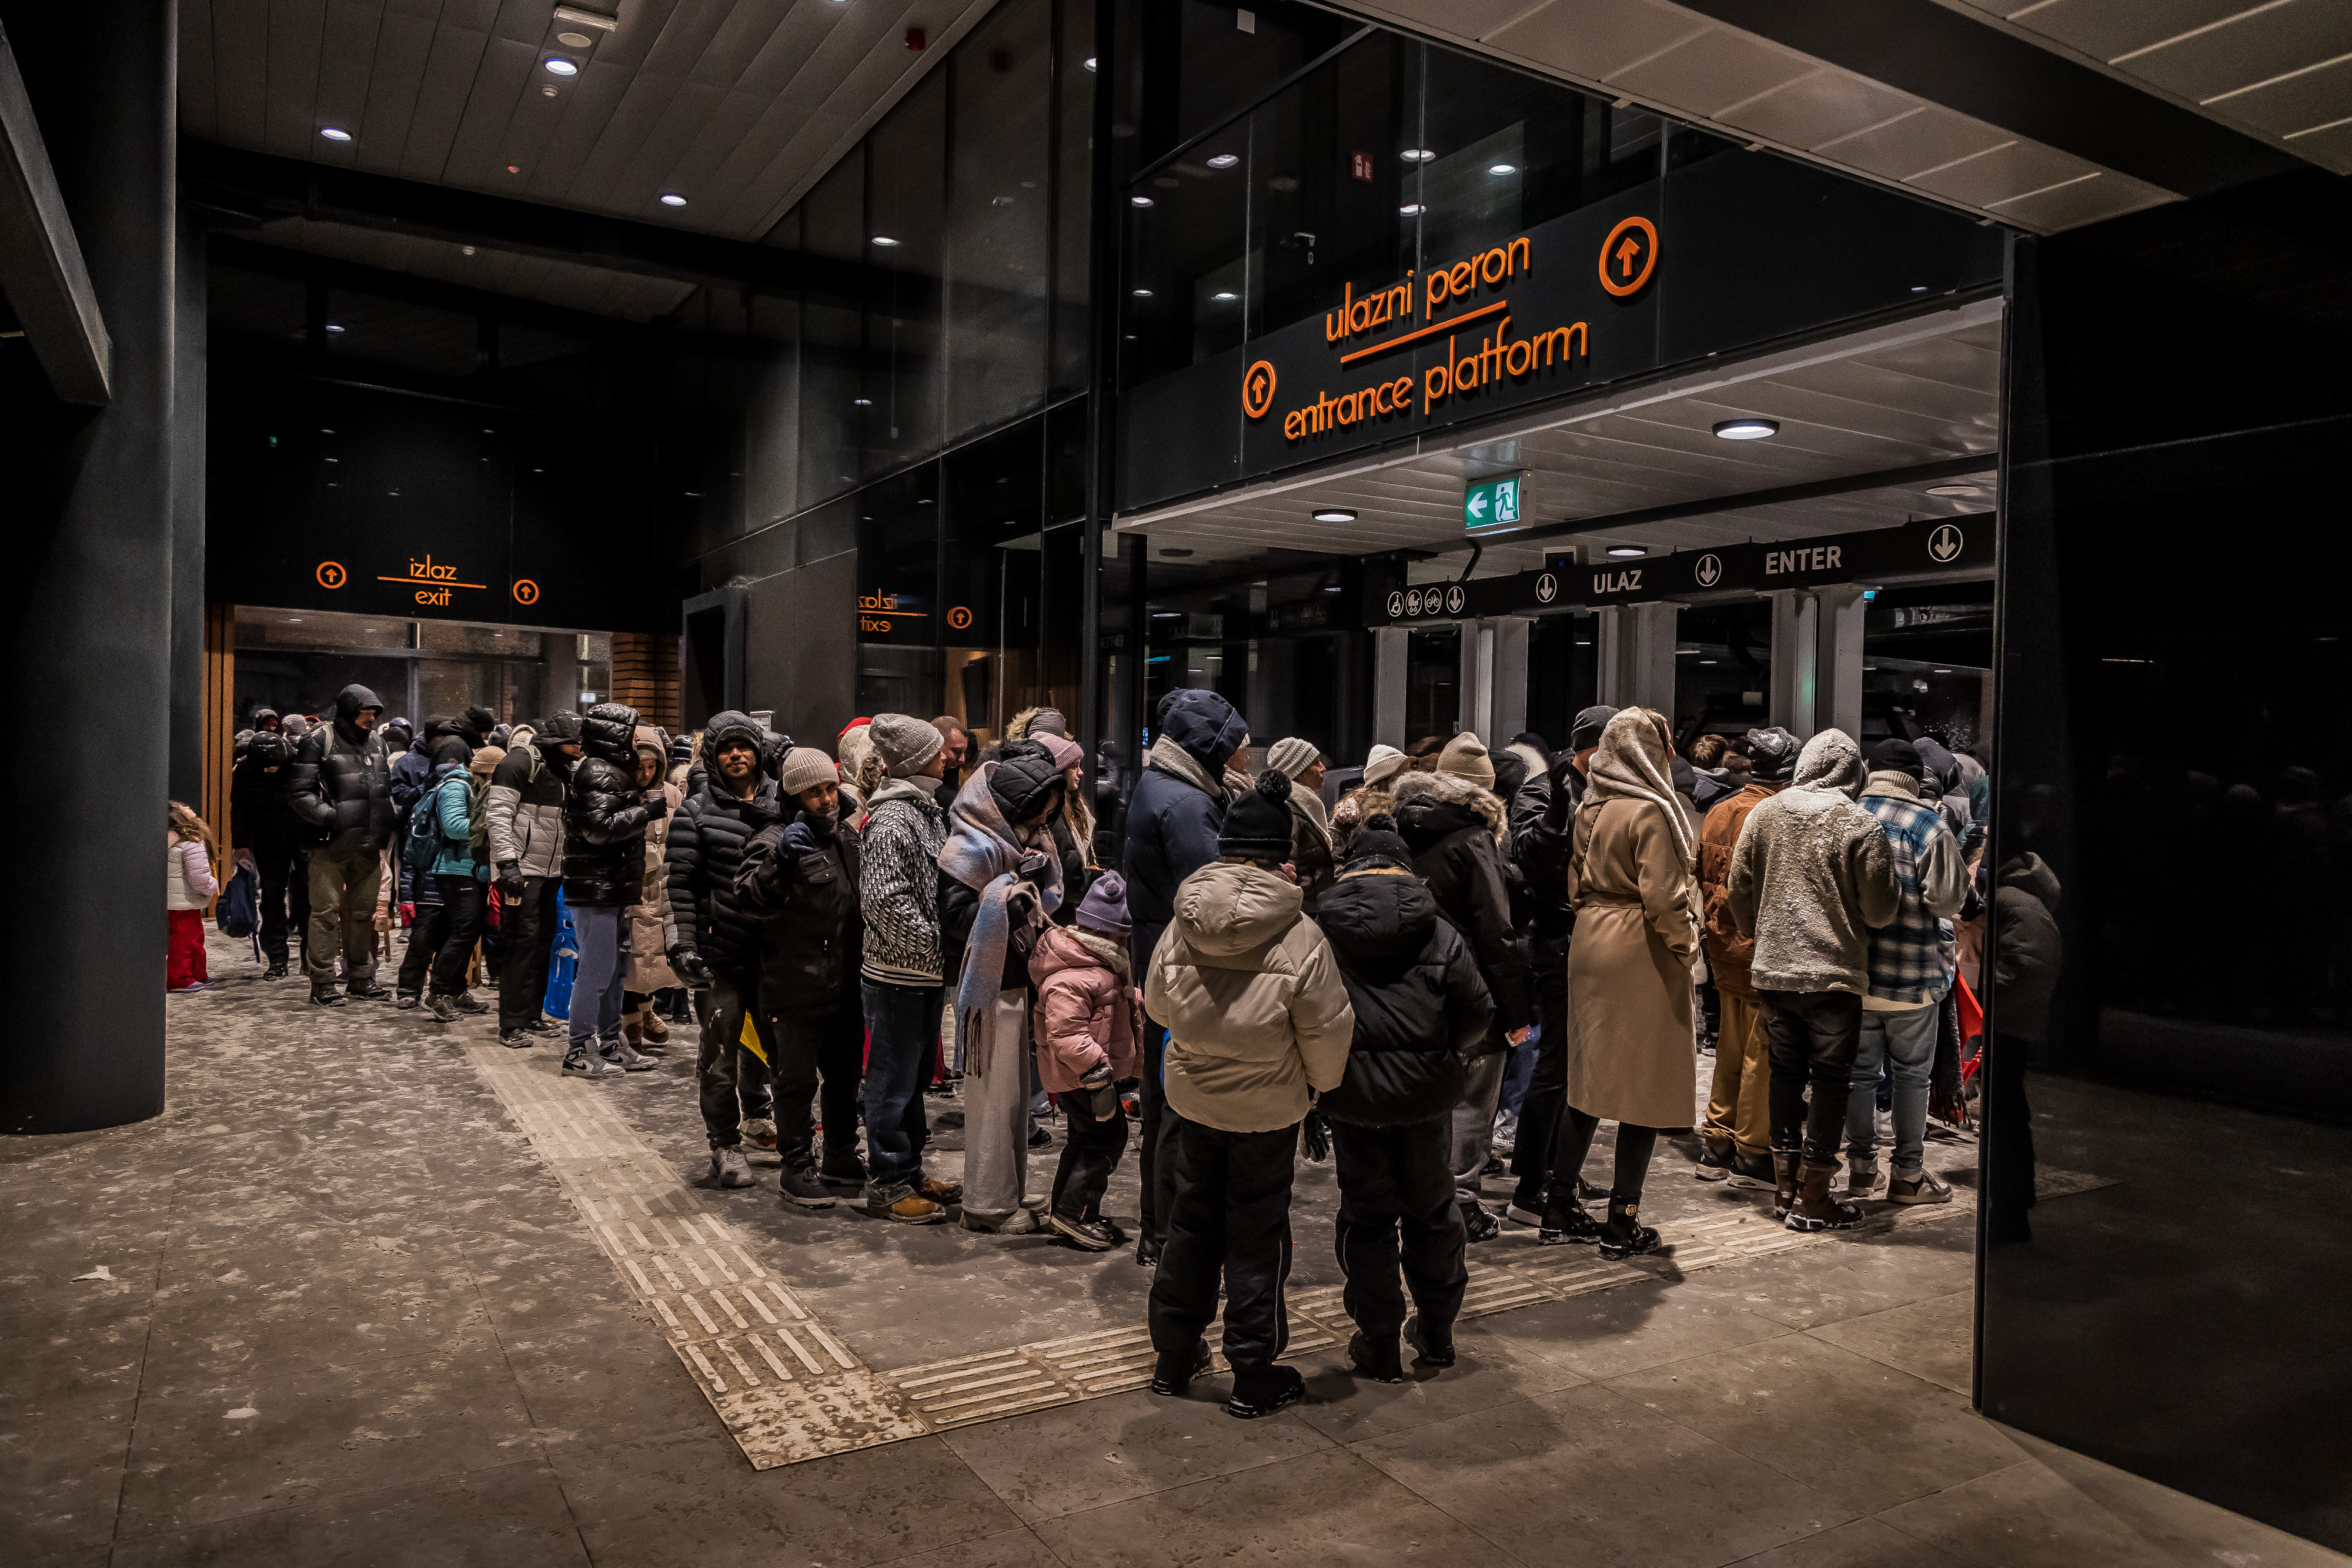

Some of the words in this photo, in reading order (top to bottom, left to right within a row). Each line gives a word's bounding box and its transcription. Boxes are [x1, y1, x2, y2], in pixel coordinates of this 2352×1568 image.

[1326, 269, 1414, 342] ulazni
[1426, 237, 1530, 320] peron
[1284, 376, 1413, 440] entrance
[1424, 316, 1588, 415] platform
[410, 554, 457, 580] izlaz
[1594, 570, 1642, 594] ULAZ
[1766, 546, 1842, 574] ENTER
[415, 587, 452, 606] exit
